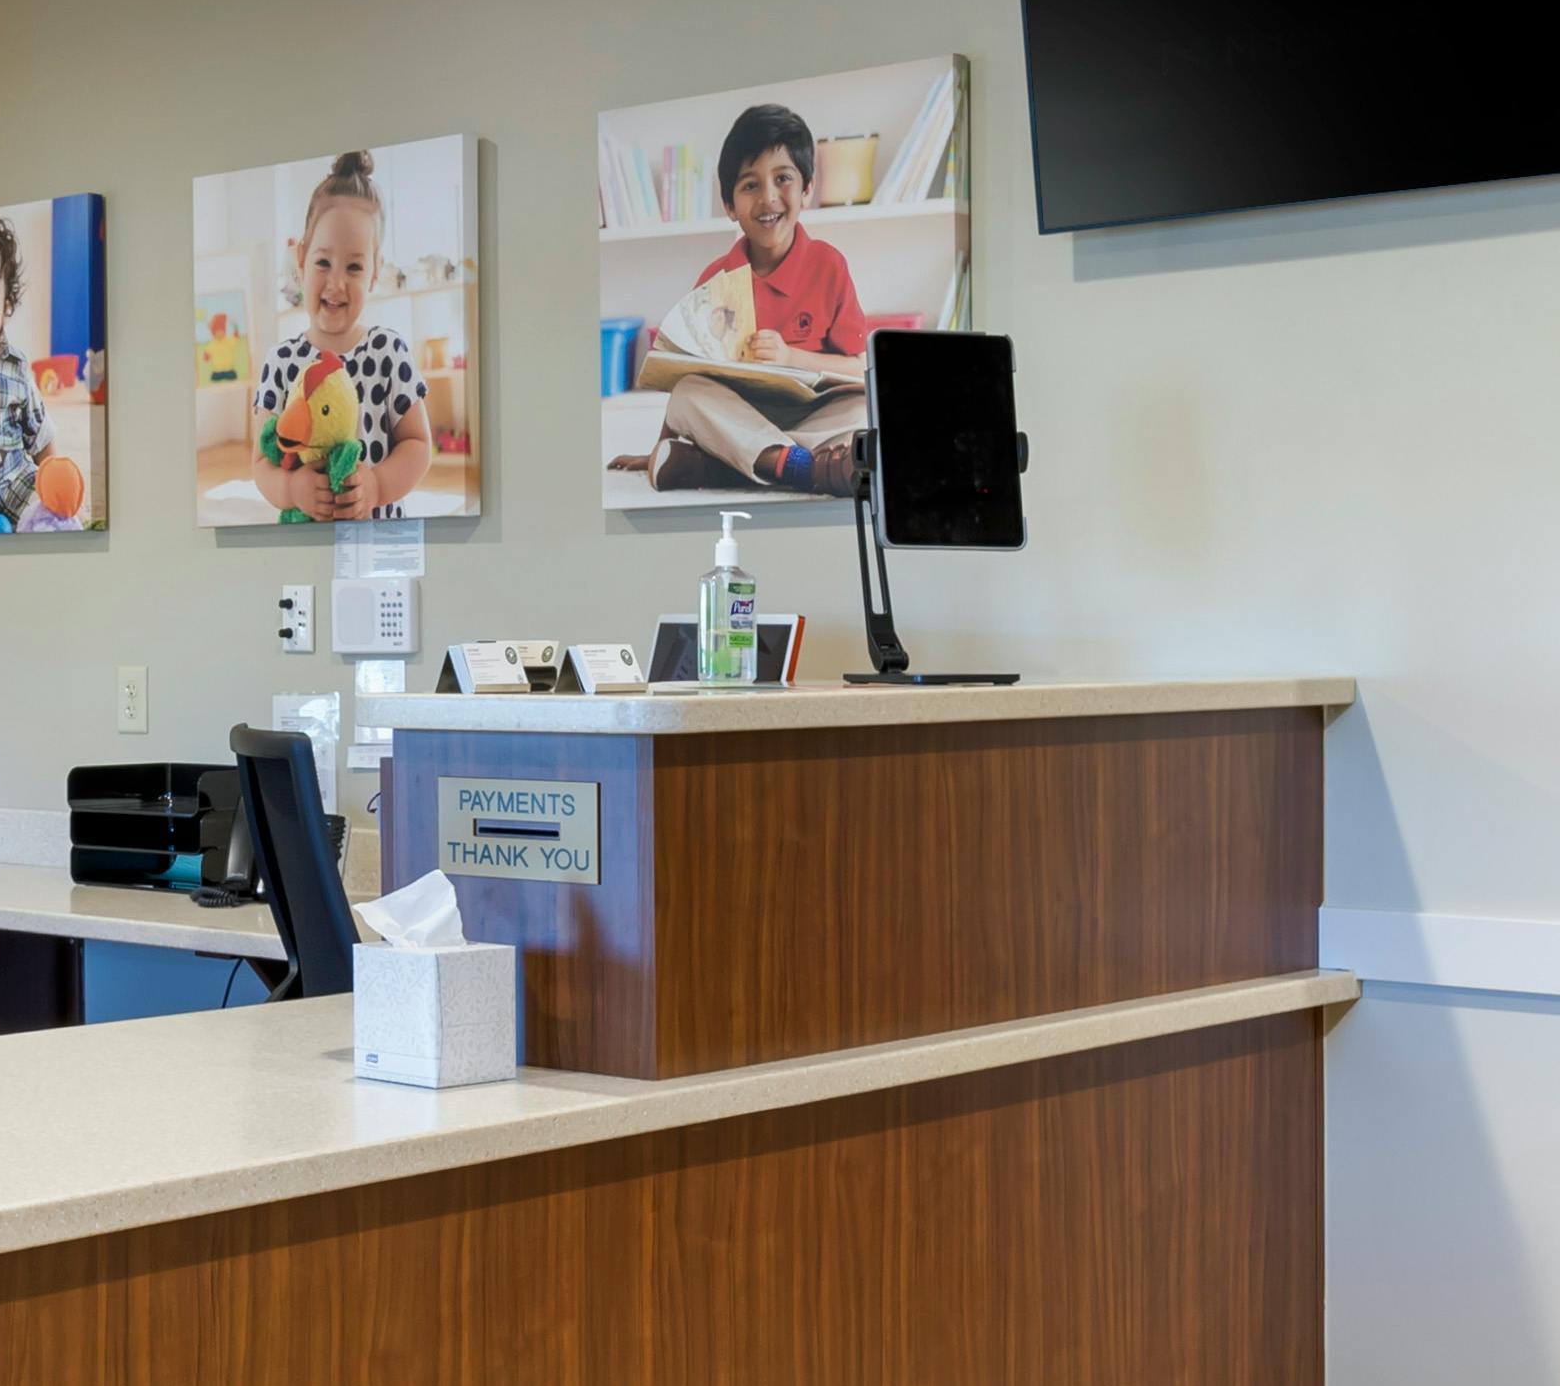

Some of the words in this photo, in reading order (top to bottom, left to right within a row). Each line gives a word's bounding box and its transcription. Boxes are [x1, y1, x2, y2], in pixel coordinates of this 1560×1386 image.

[459, 789, 576, 817] PAYMENTS
[447, 841, 529, 868] THANK
[540, 845, 590, 871] YOU
